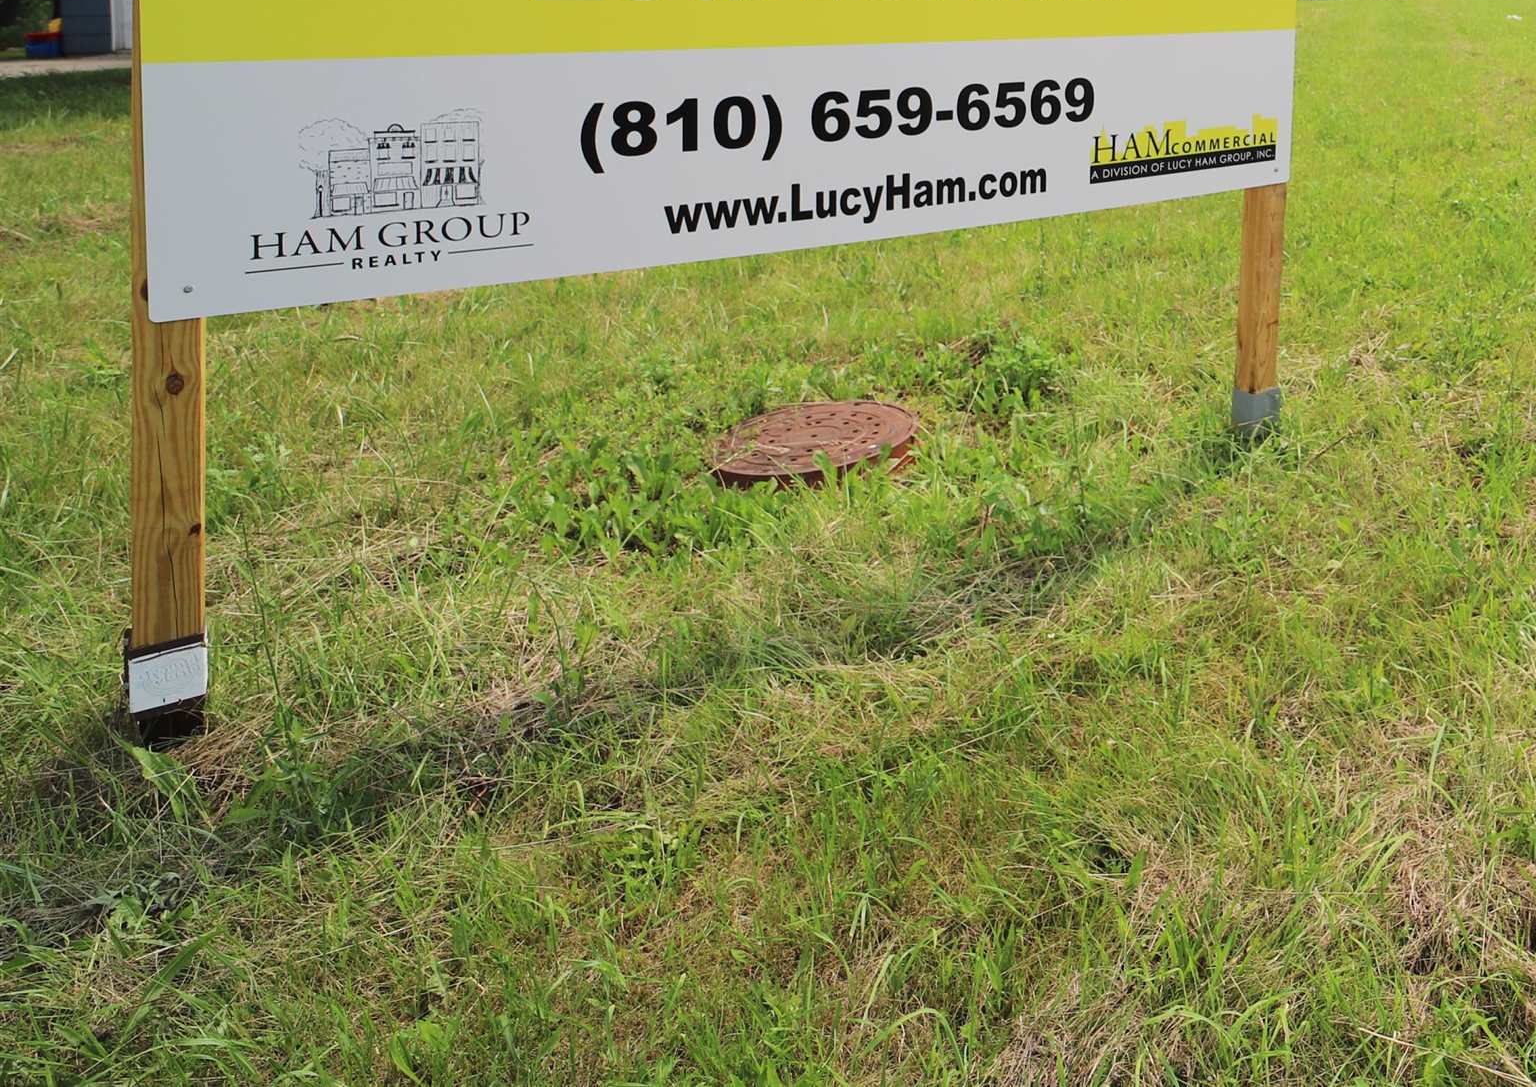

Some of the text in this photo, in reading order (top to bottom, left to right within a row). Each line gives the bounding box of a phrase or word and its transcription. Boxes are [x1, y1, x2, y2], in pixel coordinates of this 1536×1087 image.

[580, 78, 1095, 174] (810) 659-6569
[1091, 170, 1100, 181] A
[1102, 164, 1148, 180] DIVISION
[1151, 161, 1165, 173] OF
[1167, 158, 1193, 171] LUCY
[1195, 156, 1217, 167] HAM
[1256, 148, 1276, 159] INC.
[663, 168, 1047, 236] www.LucyHam.com
[250, 211, 531, 261] HAM GROUP
[351, 249, 442, 270] REALTY
